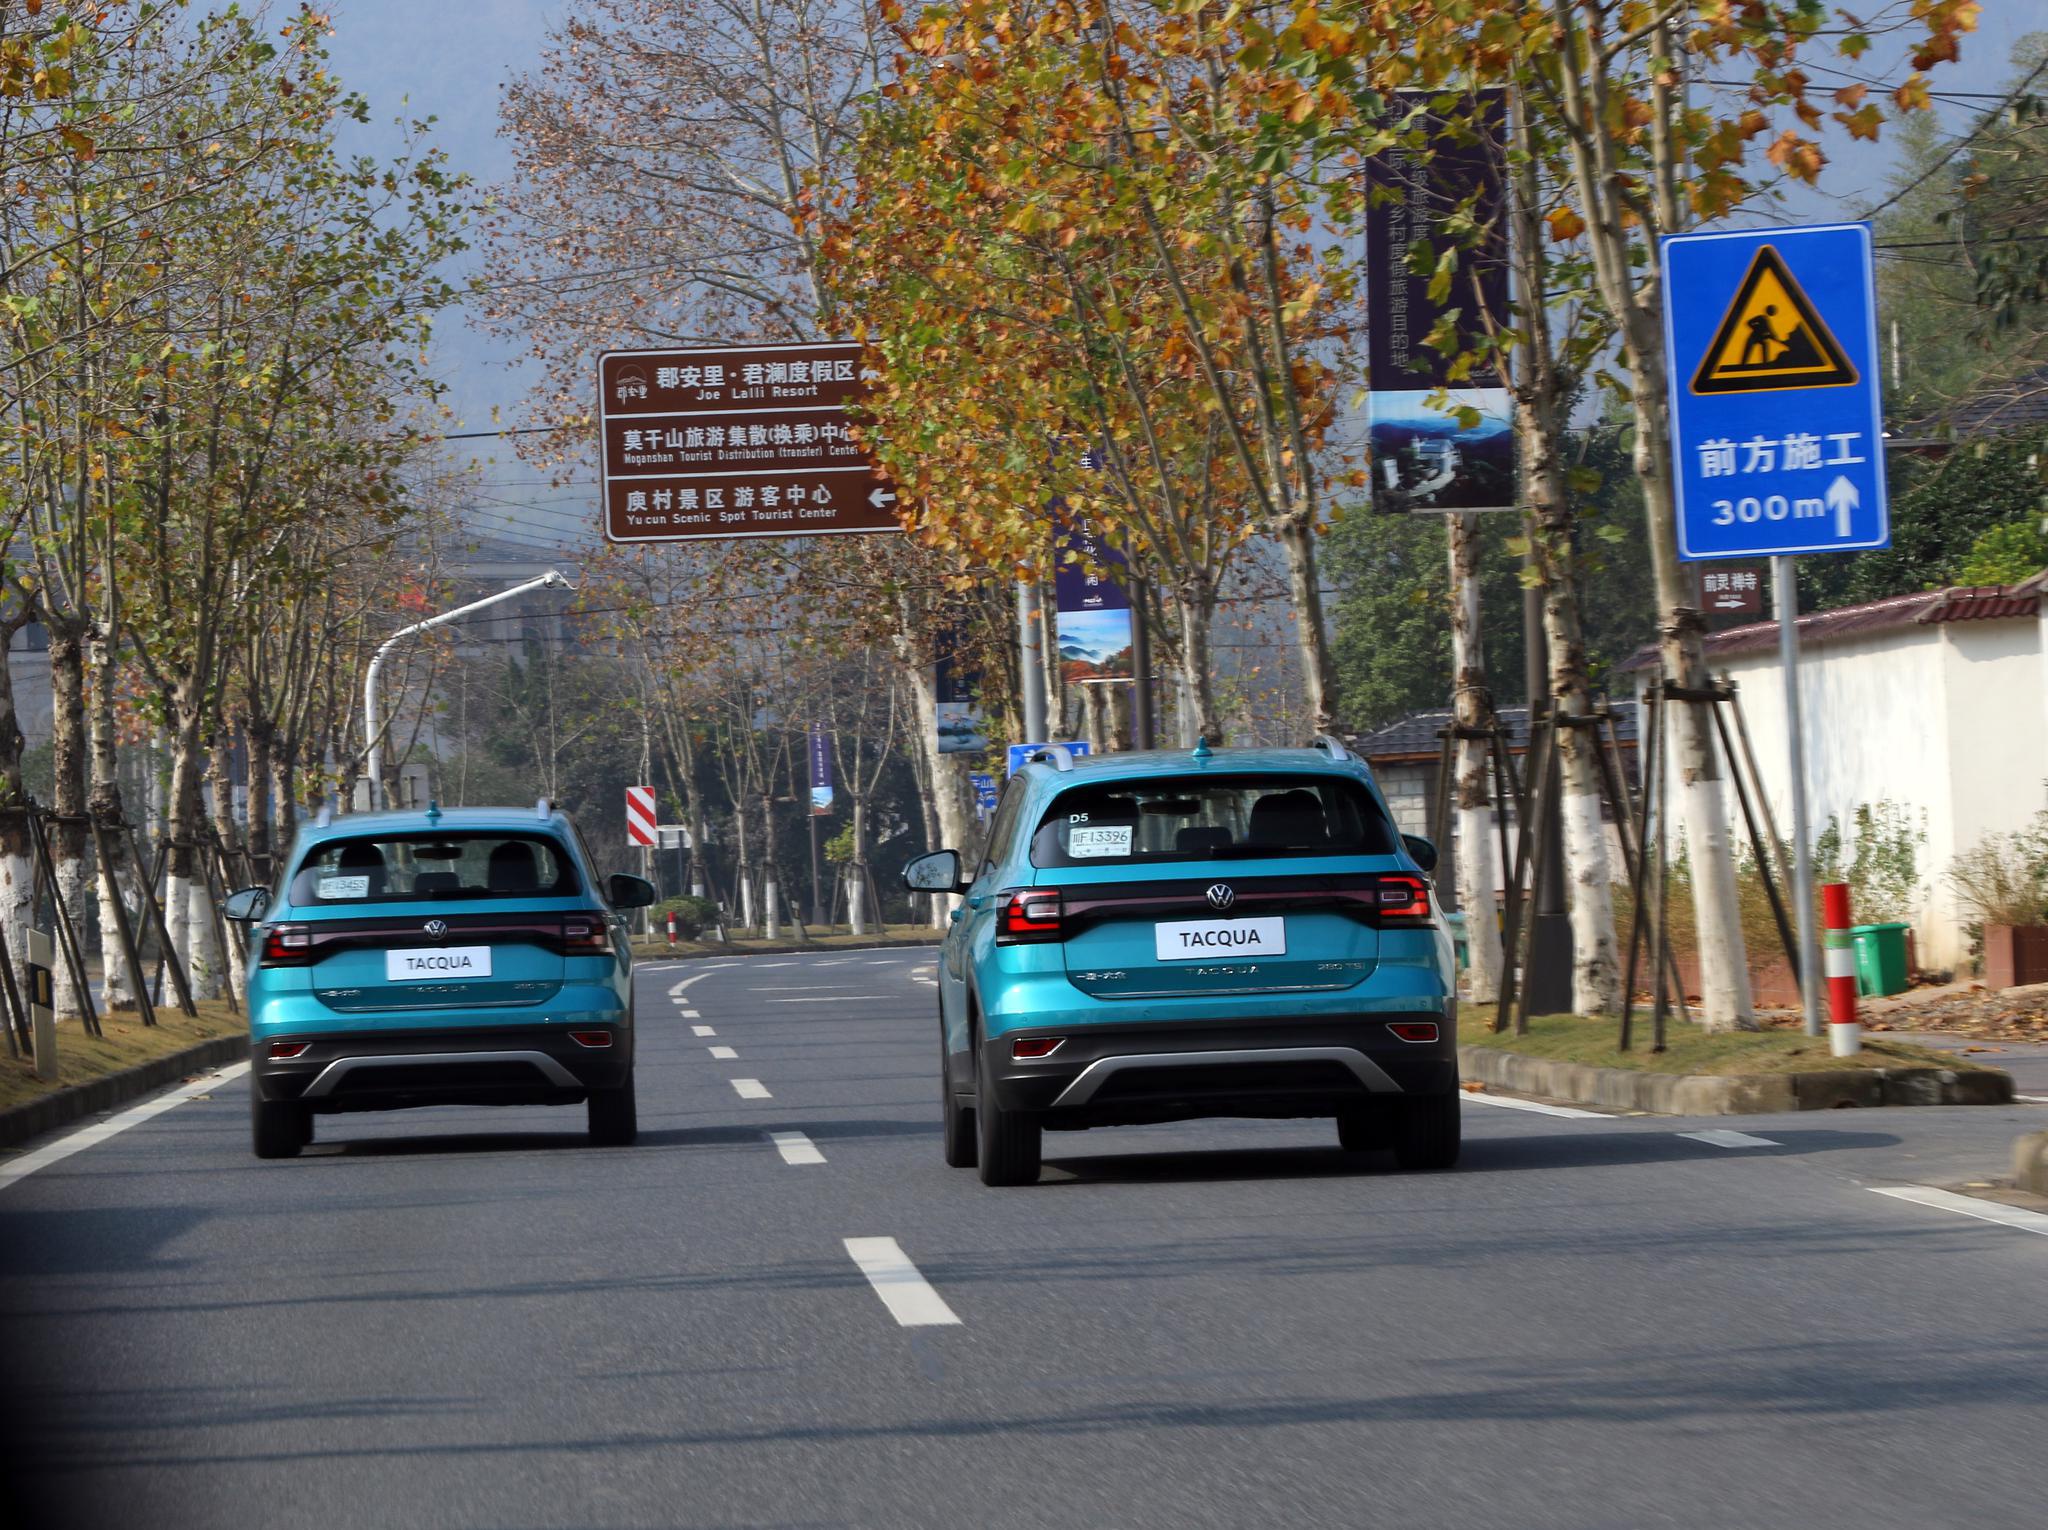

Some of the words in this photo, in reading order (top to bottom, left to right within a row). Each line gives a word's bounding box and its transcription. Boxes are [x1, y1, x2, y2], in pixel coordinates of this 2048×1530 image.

[656, 360, 856, 388] 郡安里·君澜度假区
[696, 389, 720, 401] Joe
[731, 387, 765, 399] Lalli
[772, 385, 818, 397] Resort
[624, 452, 674, 466] Moganshan
[679, 450, 713, 463] Tourist
[718, 448, 775, 461] Distribution
[779, 446, 823, 459] (transfer)
[1697, 432, 1866, 478] 前方施工
[673, 512, 711, 524] Scenic
[719, 511, 746, 524] Spot
[751, 509, 793, 521] Tourist
[799, 507, 838, 519] Center
[1069, 812, 1089, 824] D5
[1179, 929, 1262, 948] TACQUA
[405, 955, 473, 971] TACQUA
